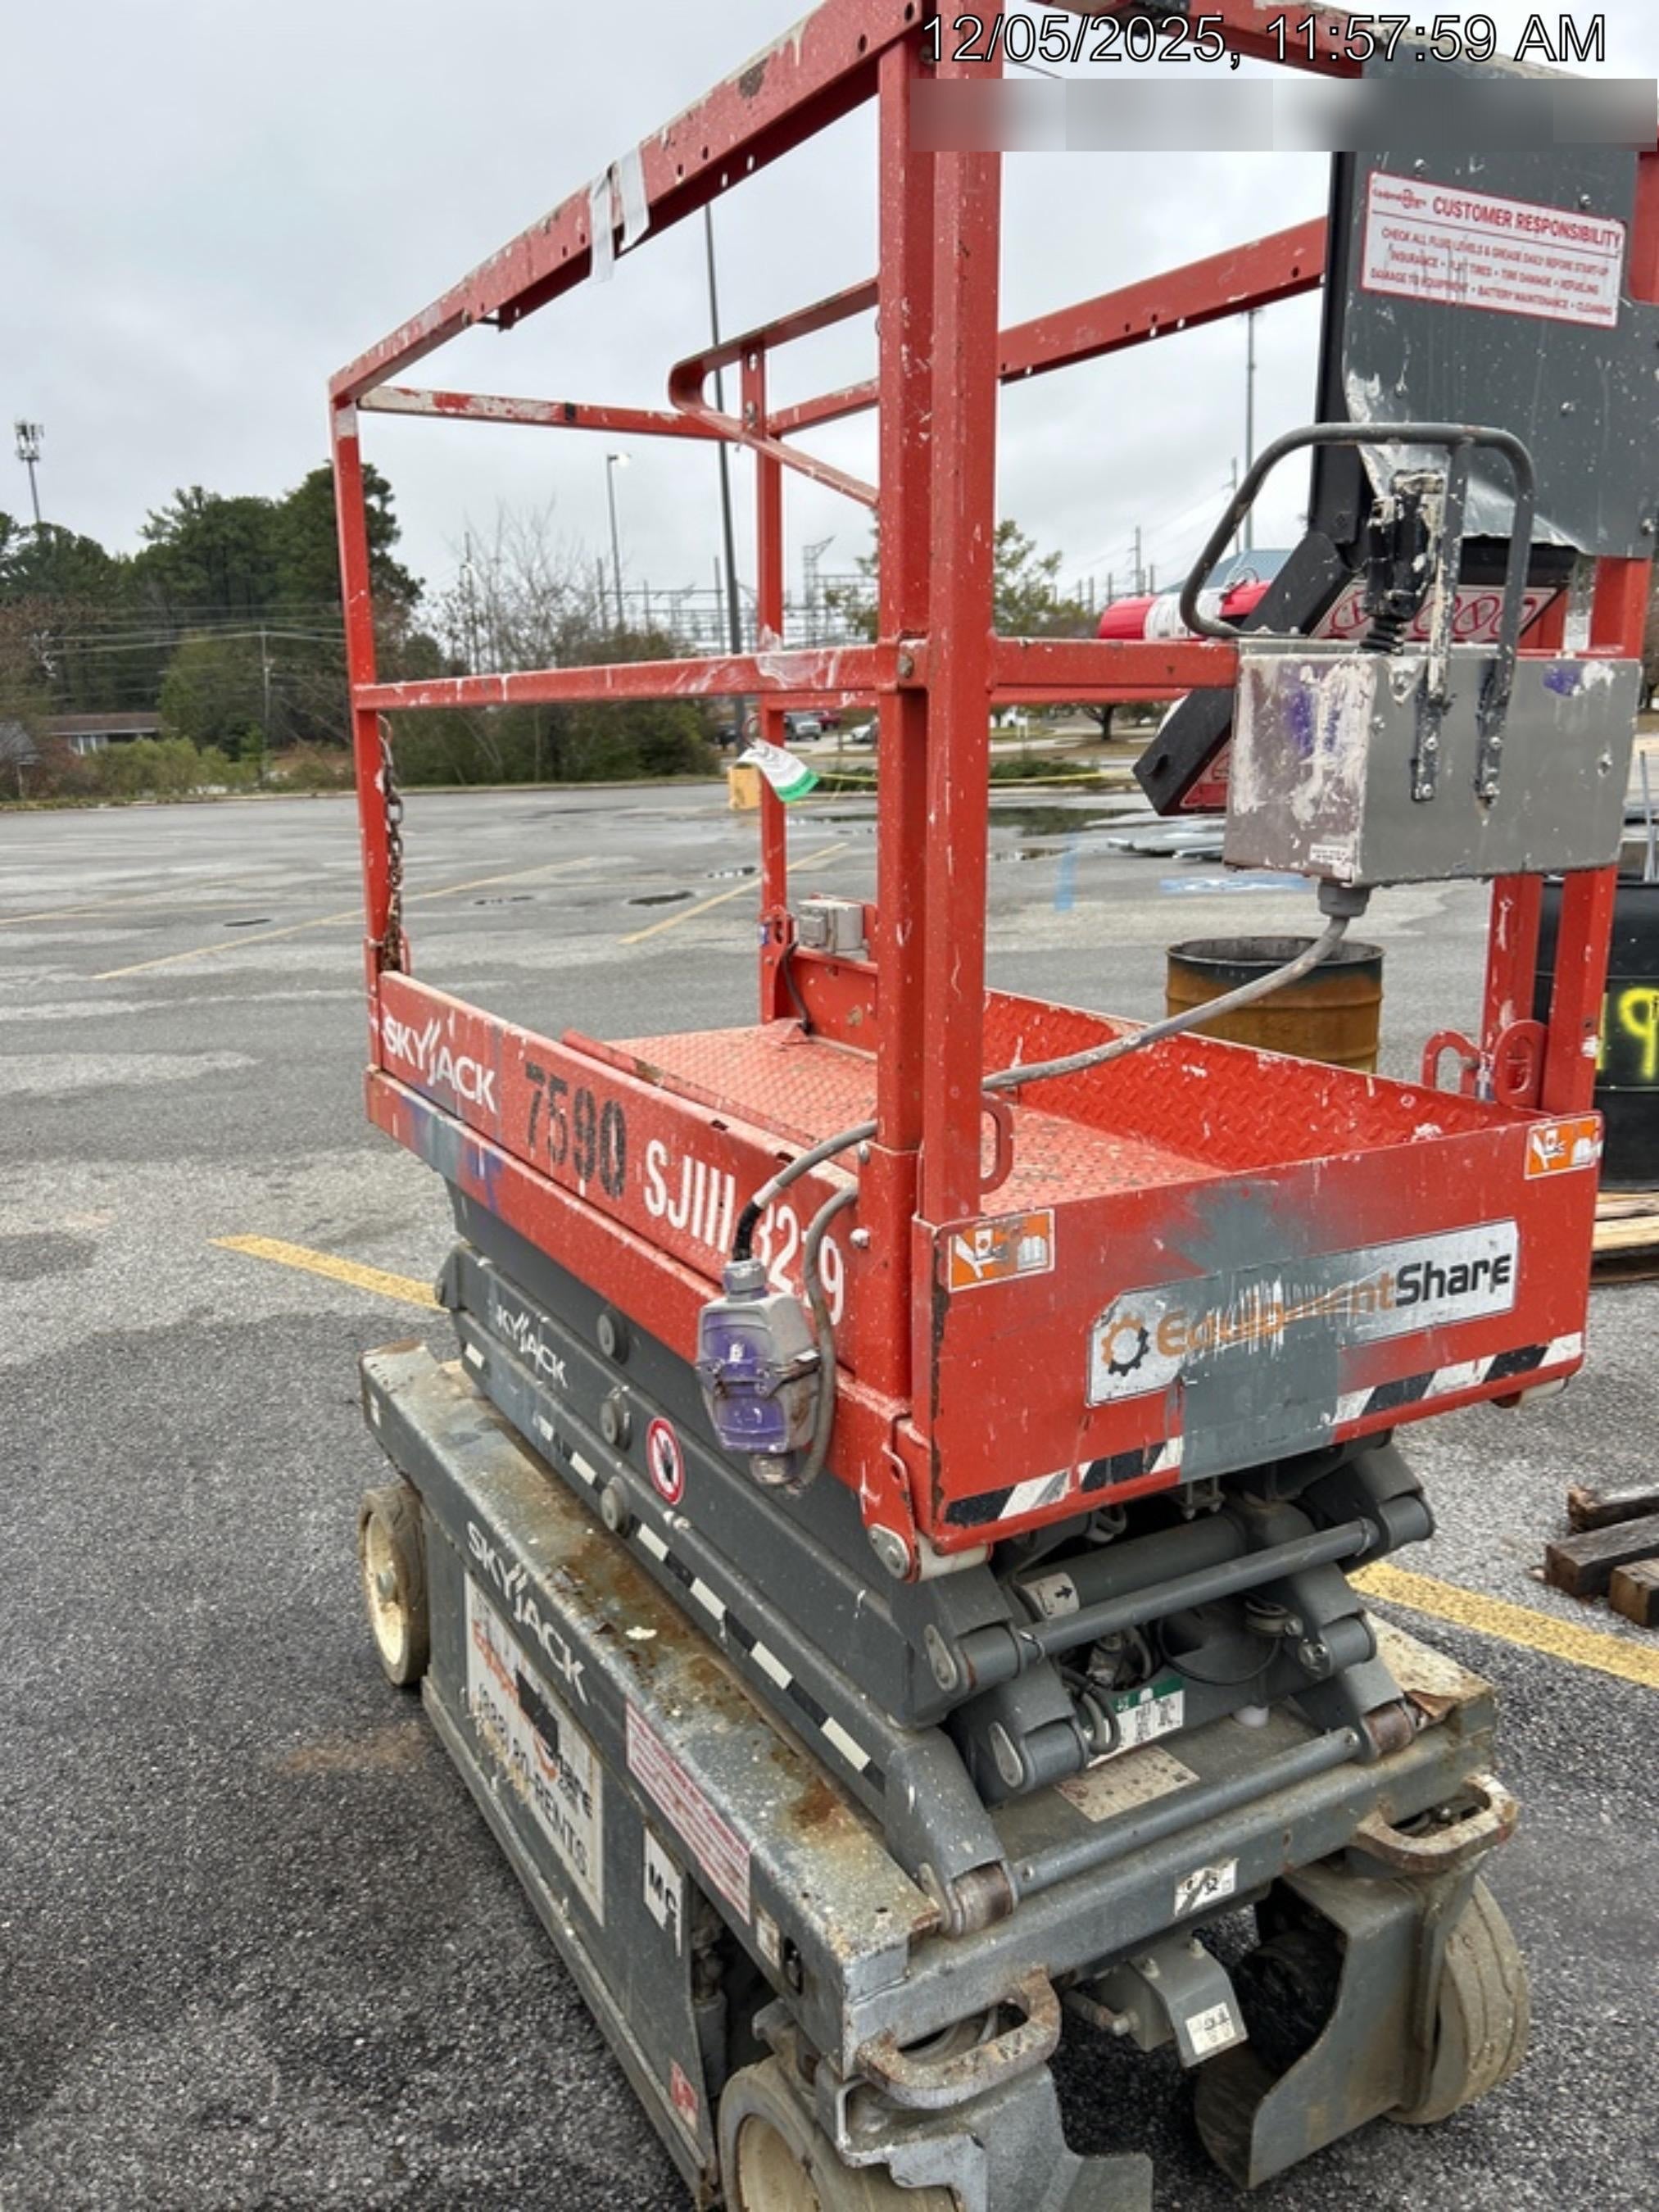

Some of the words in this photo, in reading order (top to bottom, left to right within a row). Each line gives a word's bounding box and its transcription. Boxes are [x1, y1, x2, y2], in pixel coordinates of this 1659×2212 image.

[1381, 226, 1409, 242] CHECK
[1412, 233, 1426, 245] ALL
[1433, 196, 1512, 227] CUSTOMER
[1515, 212, 1621, 248] RESPONSIBILITY
[382, 1014, 498, 1115] SKYJACK
[525, 1062, 626, 1200] 7590
[487, 1299, 568, 1389] KYJACK
[467, 1521, 589, 1705] SKYJACK
